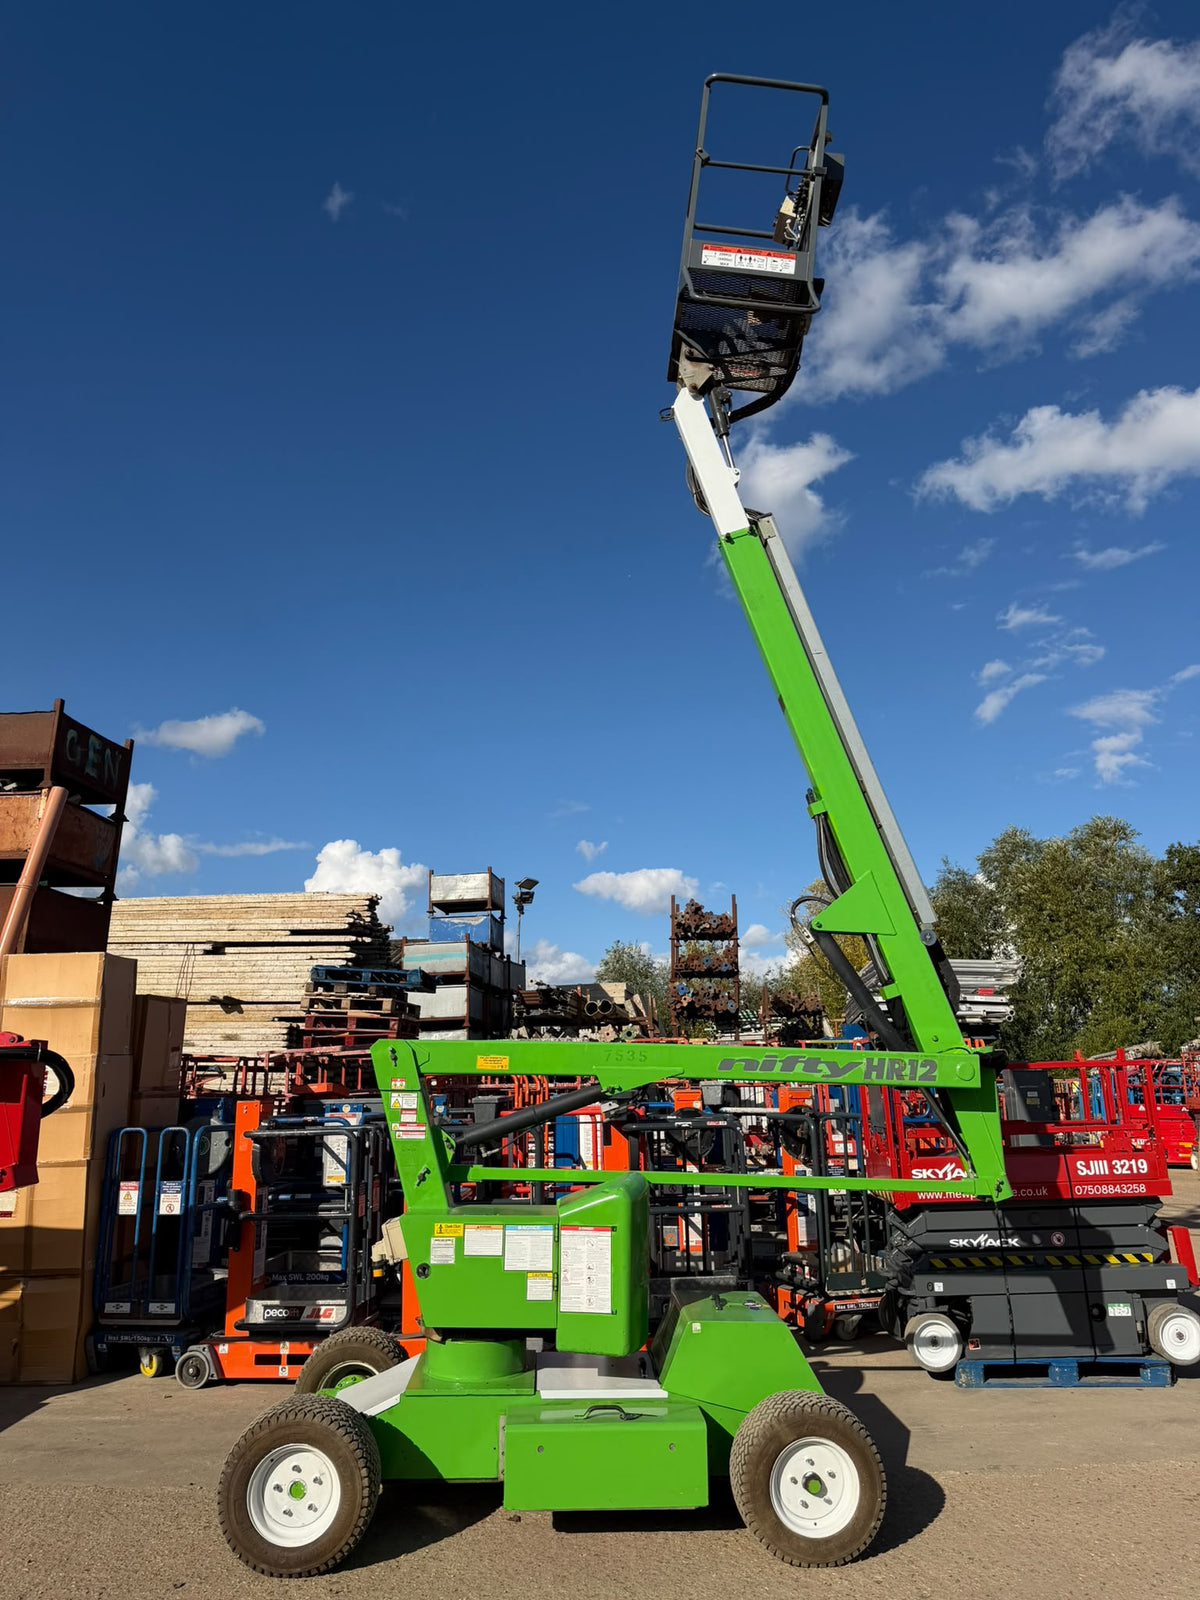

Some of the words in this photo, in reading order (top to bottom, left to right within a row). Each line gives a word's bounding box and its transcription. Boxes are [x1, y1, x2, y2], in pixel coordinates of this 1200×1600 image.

[717, 1052, 864, 1079] nifty
[863, 1057, 938, 1082] HR12
[911, 1163, 967, 1181] SKYJA
[1076, 1160, 1109, 1176] SJIII
[1111, 1159, 1148, 1174] 3219
[1074, 1184, 1146, 1195] 07508843258
[949, 1233, 1021, 1250] SKYJACK
[272, 1273, 287, 1281] Max
[288, 1273, 304, 1281] SWL
[306, 1273, 329, 1282] 200kg
[306, 1307, 335, 1319] JLG
